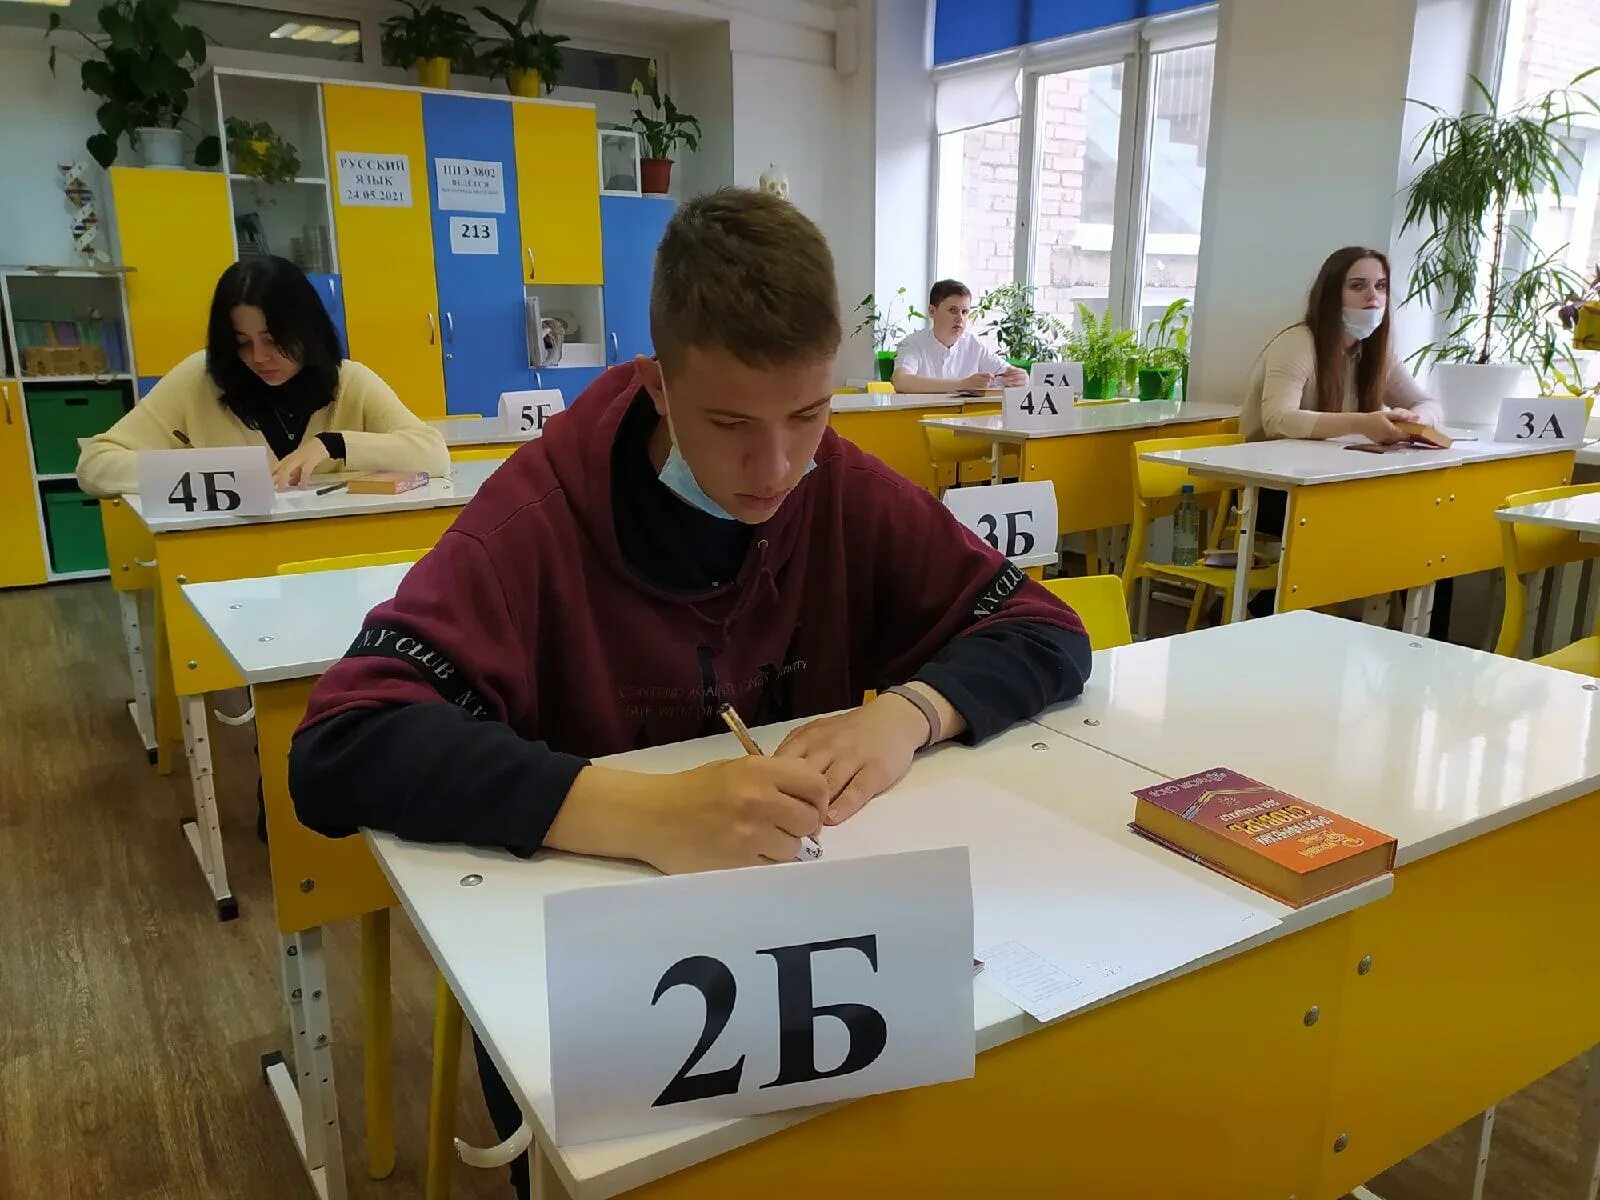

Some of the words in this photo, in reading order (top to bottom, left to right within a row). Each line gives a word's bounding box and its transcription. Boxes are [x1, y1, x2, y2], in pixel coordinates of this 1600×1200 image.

[340, 158, 405, 171] РУССКИЙ
[472, 167, 497, 179] 3802
[355, 174, 393, 186] ЯЗЫК
[347, 189, 404, 201] 24.05.2021
[461, 224, 490, 239] 213
[1020, 391, 1059, 415] 4А
[1516, 411, 1565, 439] 3А
[167, 471, 241, 512] 4Б
[395, 637, 455, 679] CLUB
[1225, 804, 1313, 836] СЛОВАРЬ
[651, 933, 888, 1107] 2Б
